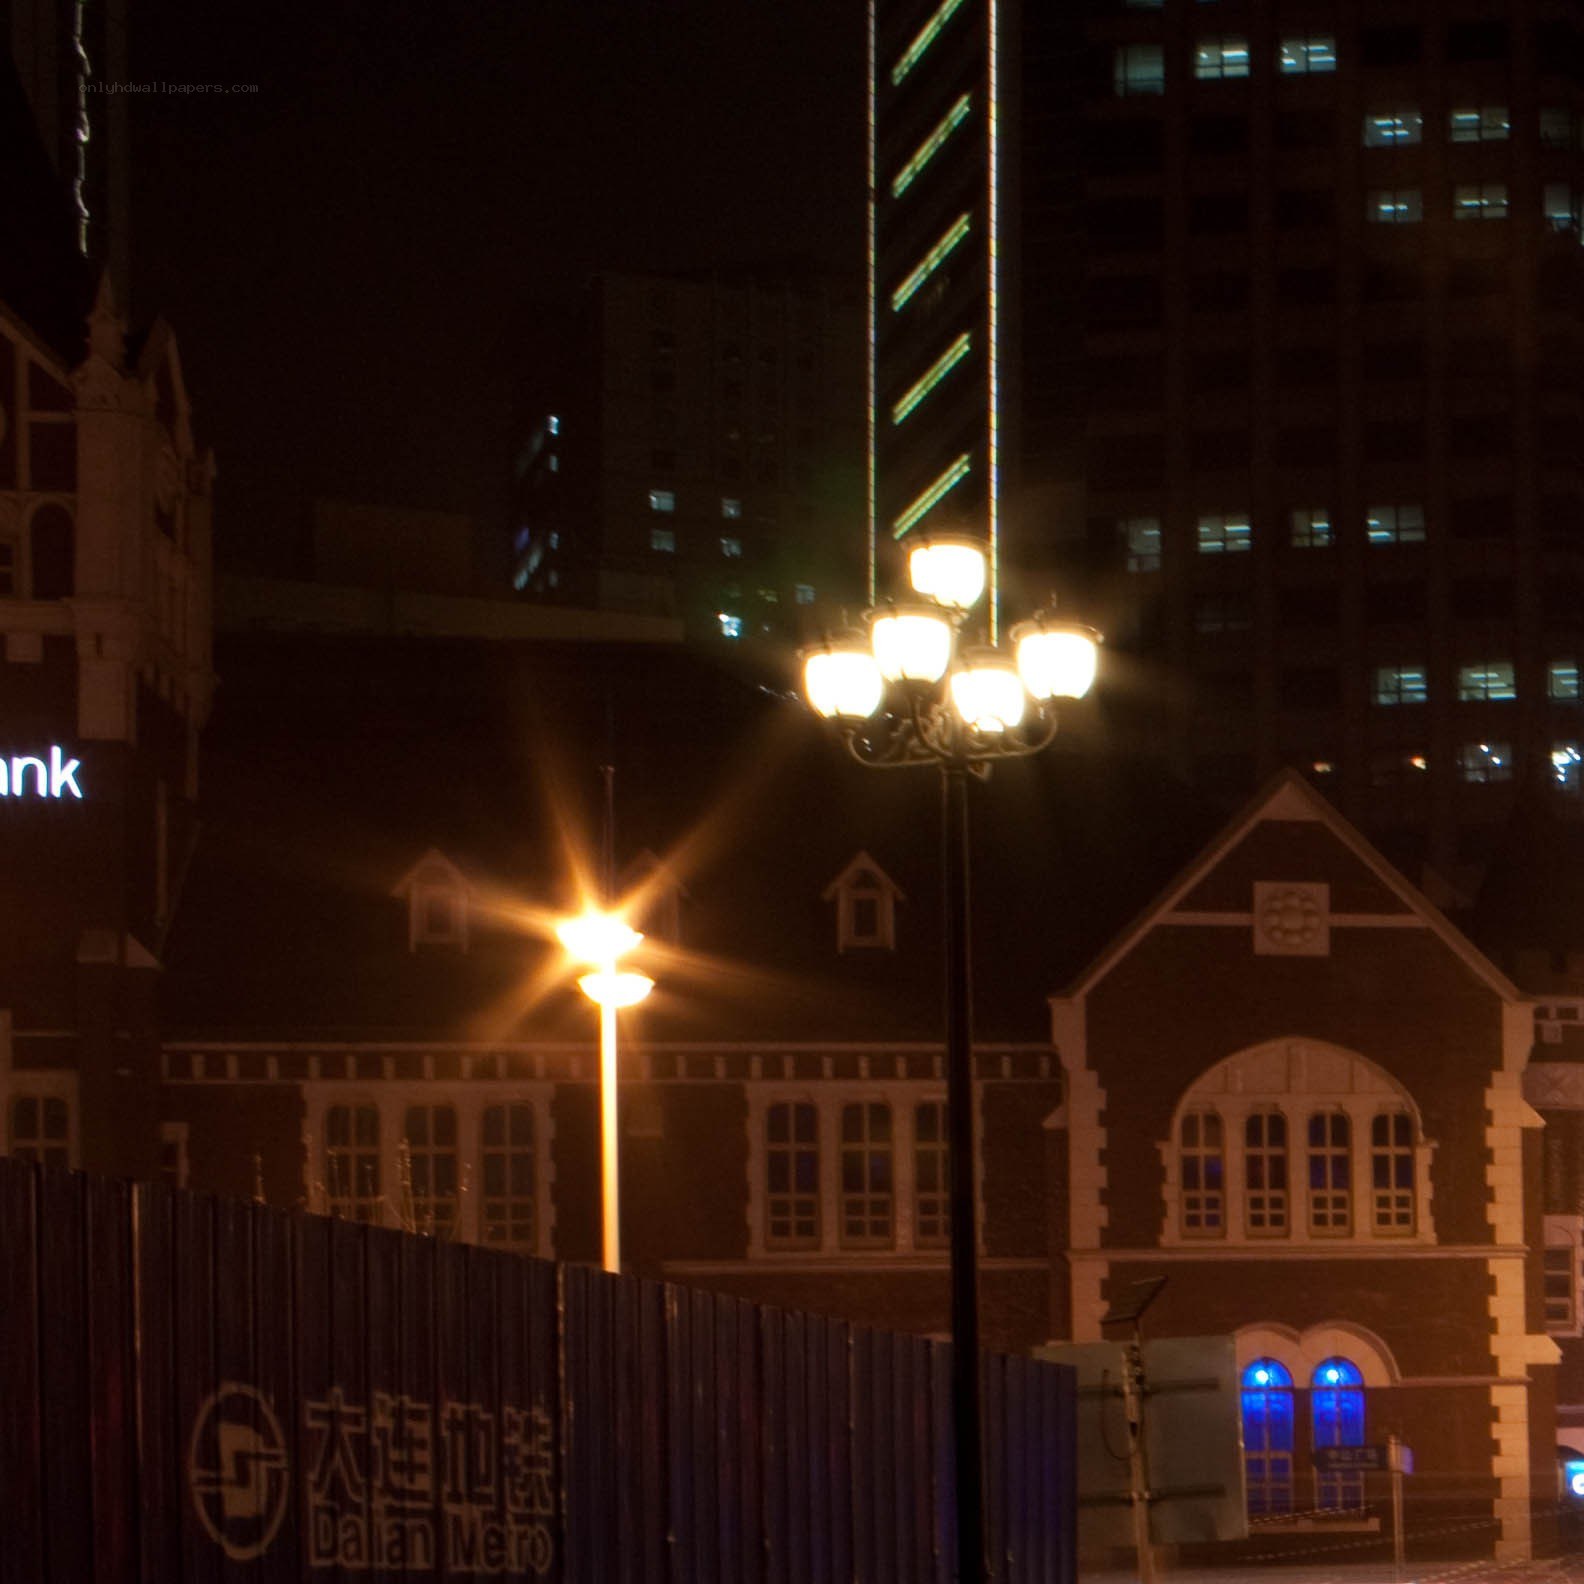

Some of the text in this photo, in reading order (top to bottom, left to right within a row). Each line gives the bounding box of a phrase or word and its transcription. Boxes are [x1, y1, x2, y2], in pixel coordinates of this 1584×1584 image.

[0, 744, 83, 799] nk
[307, 1502, 556, 1576] Dalian Metro
